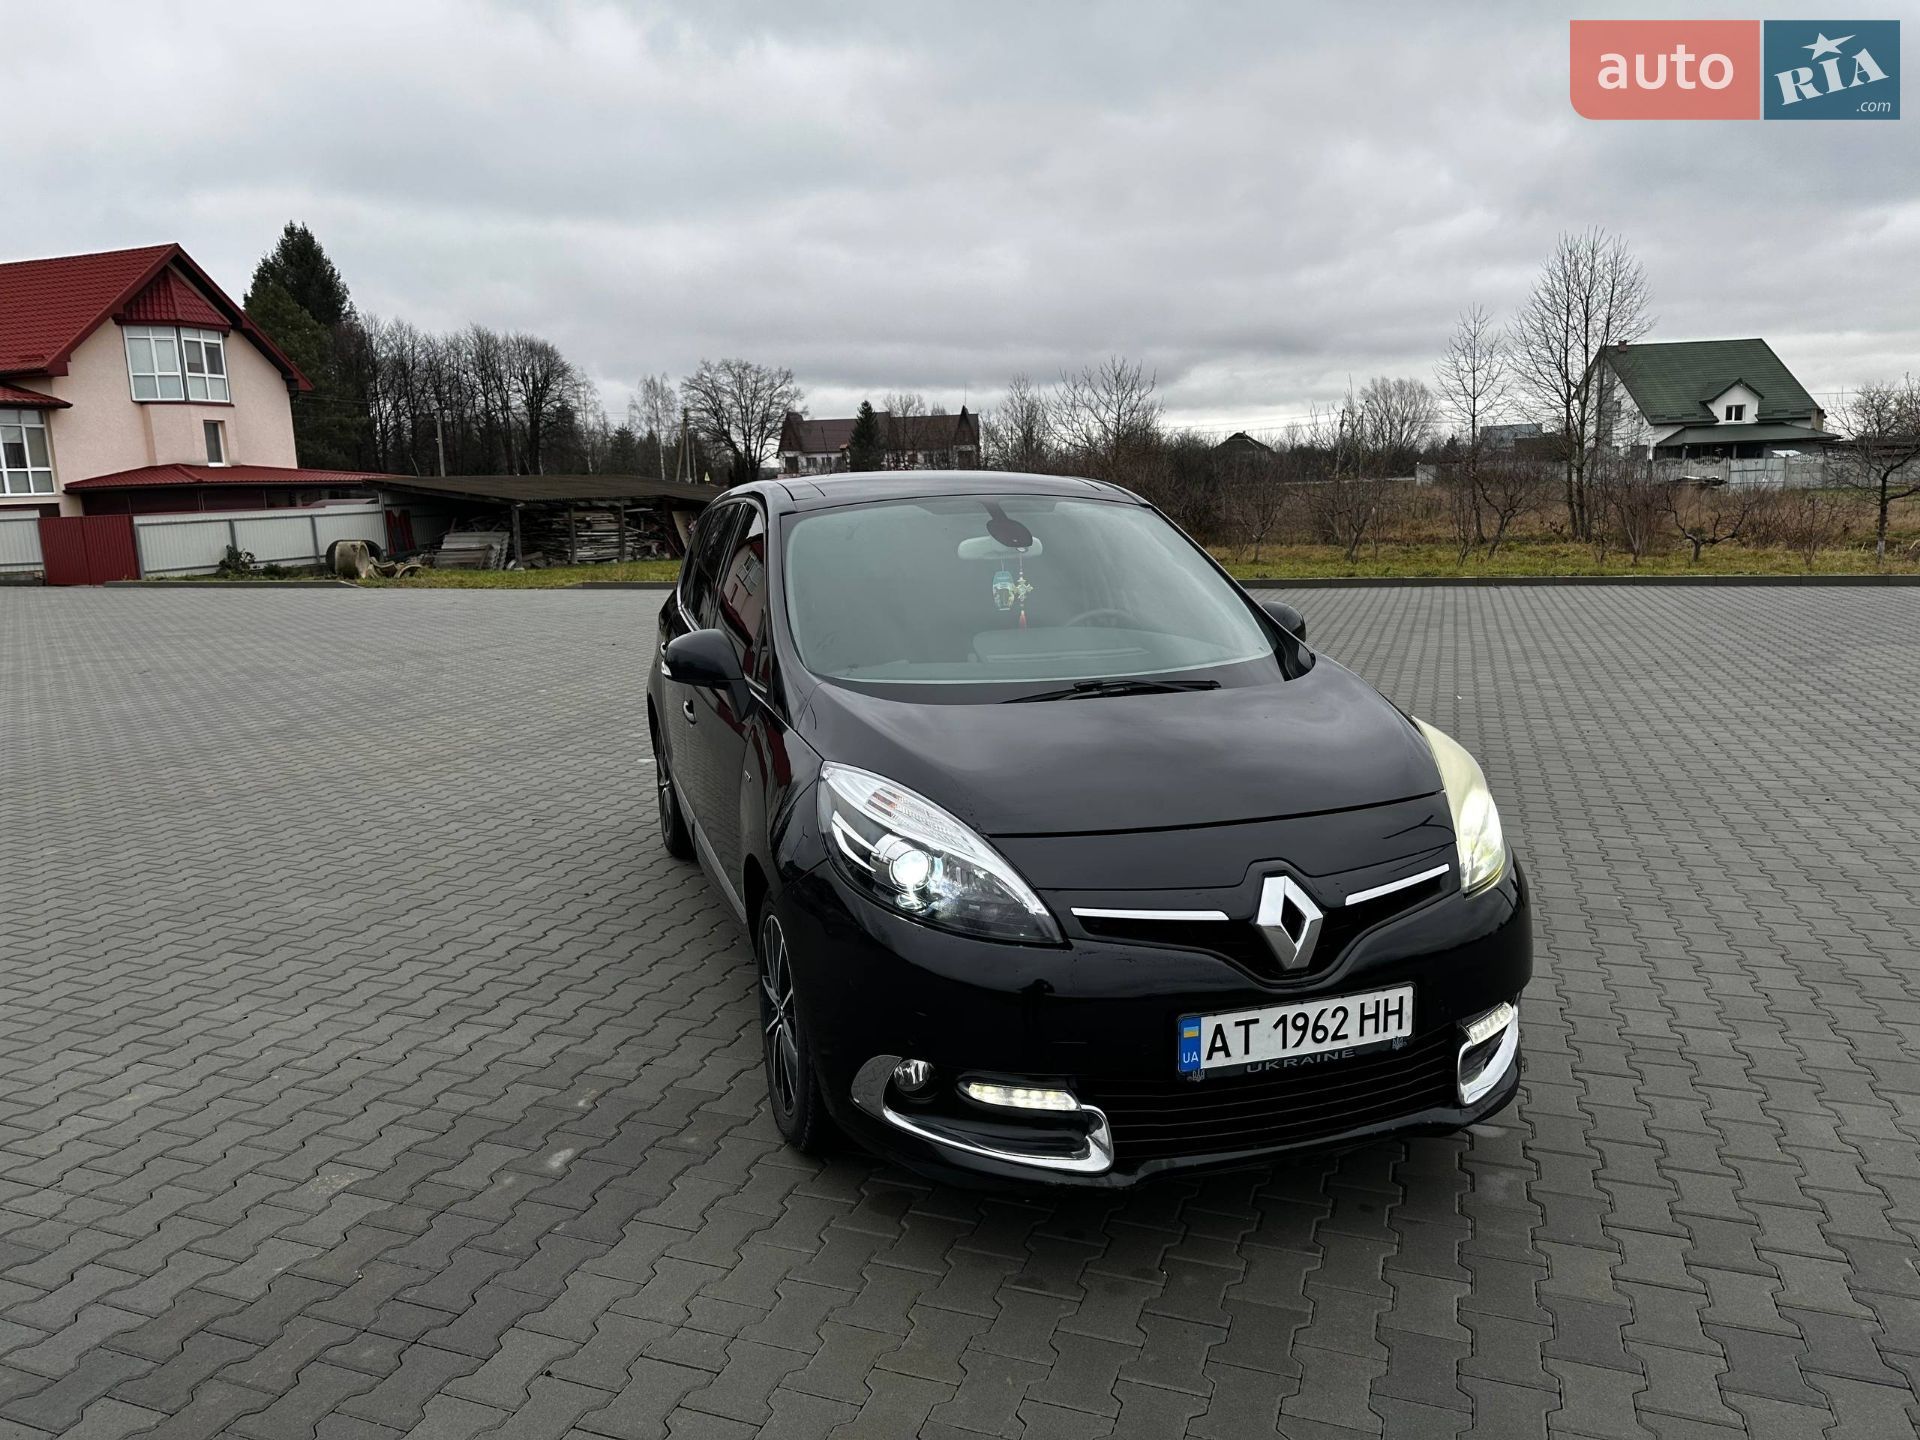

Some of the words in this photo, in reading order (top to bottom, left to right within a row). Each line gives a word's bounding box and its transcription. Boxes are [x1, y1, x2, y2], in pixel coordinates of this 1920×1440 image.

[1205, 1018, 1260, 1061] AT
[1272, 1006, 1349, 1050] 1962
[1358, 995, 1404, 1037] HH
[1182, 1051, 1199, 1064] UA
[1246, 1049, 1356, 1073] UKRAINE
